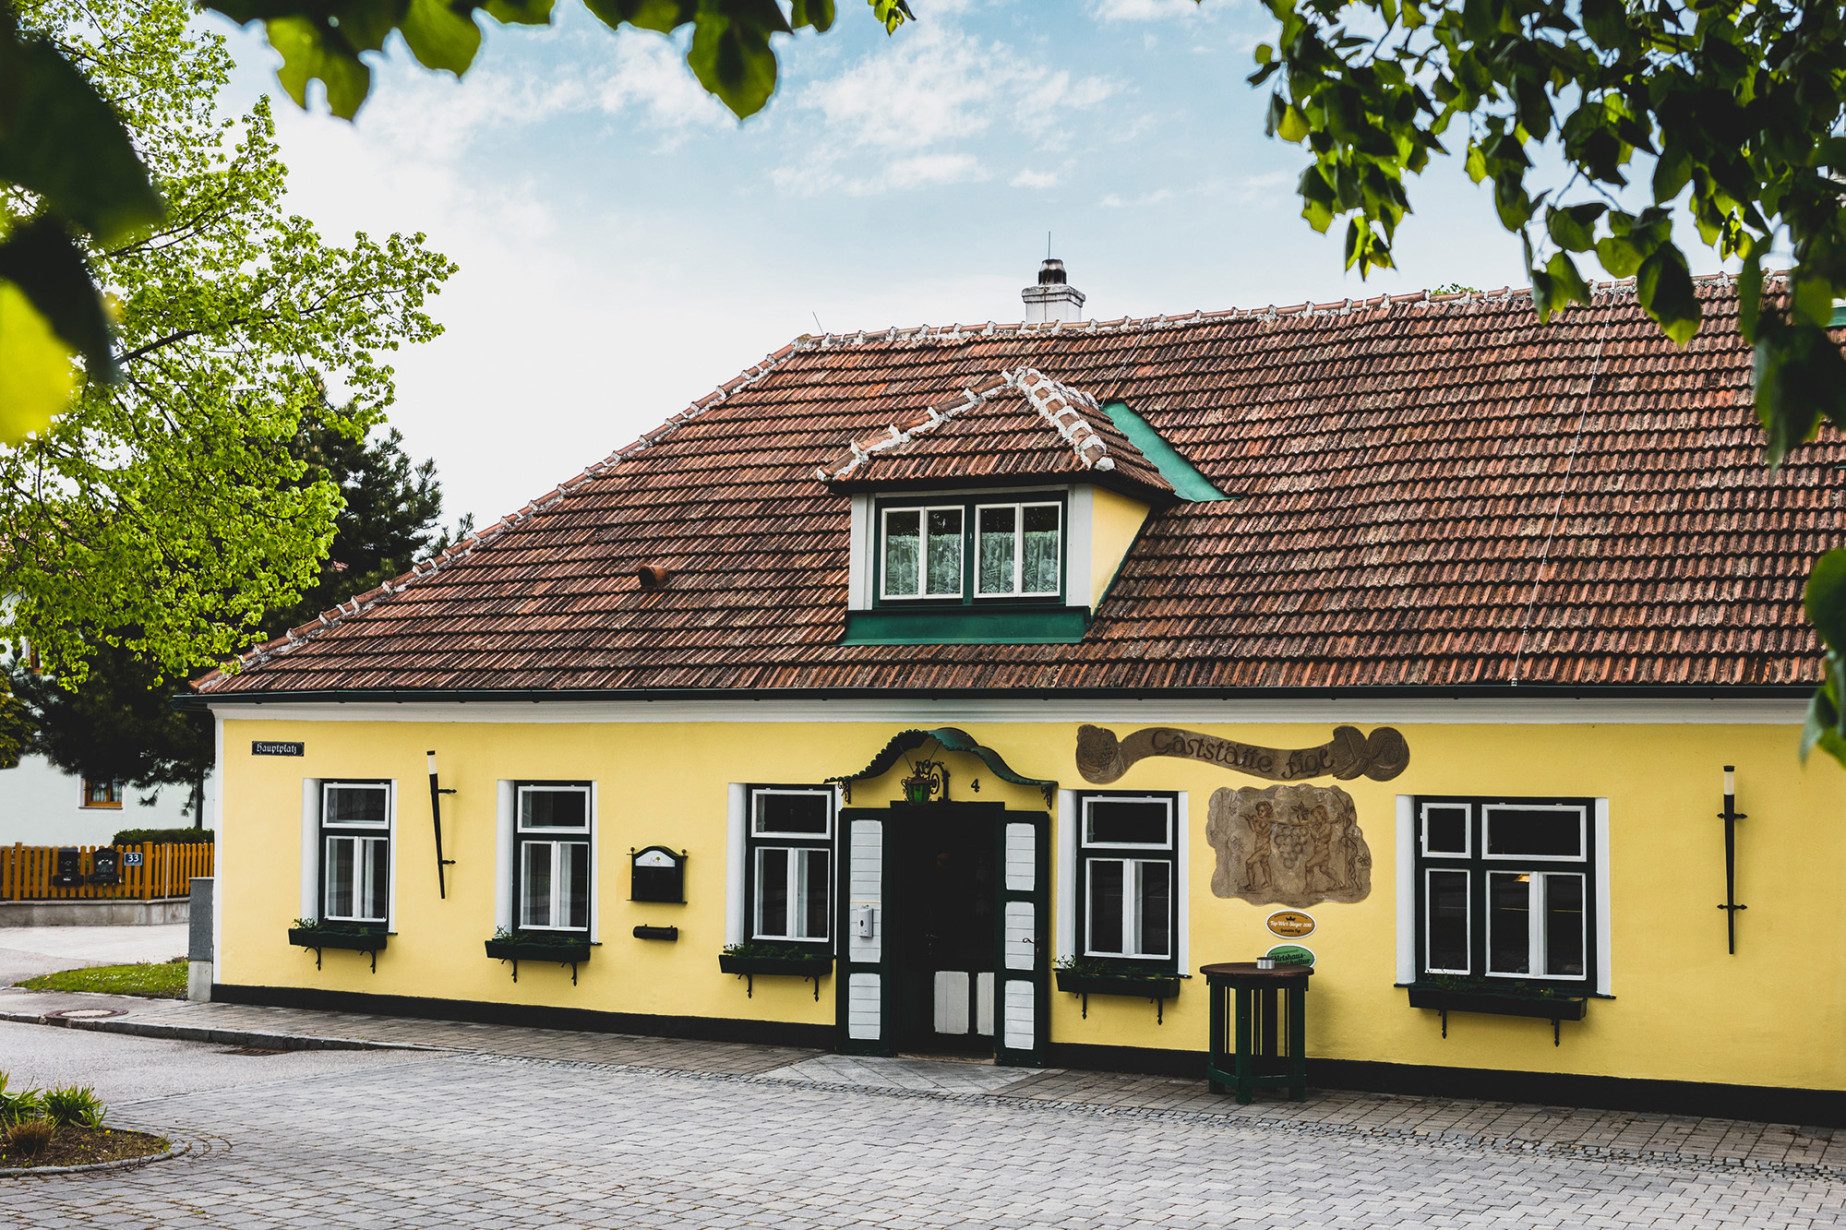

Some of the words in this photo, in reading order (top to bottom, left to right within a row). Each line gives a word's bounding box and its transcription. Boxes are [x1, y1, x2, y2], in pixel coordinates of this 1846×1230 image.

[256, 742, 297, 755] Hauptplatz
[970, 778, 981, 793] 4
[127, 854, 139, 862] 33
